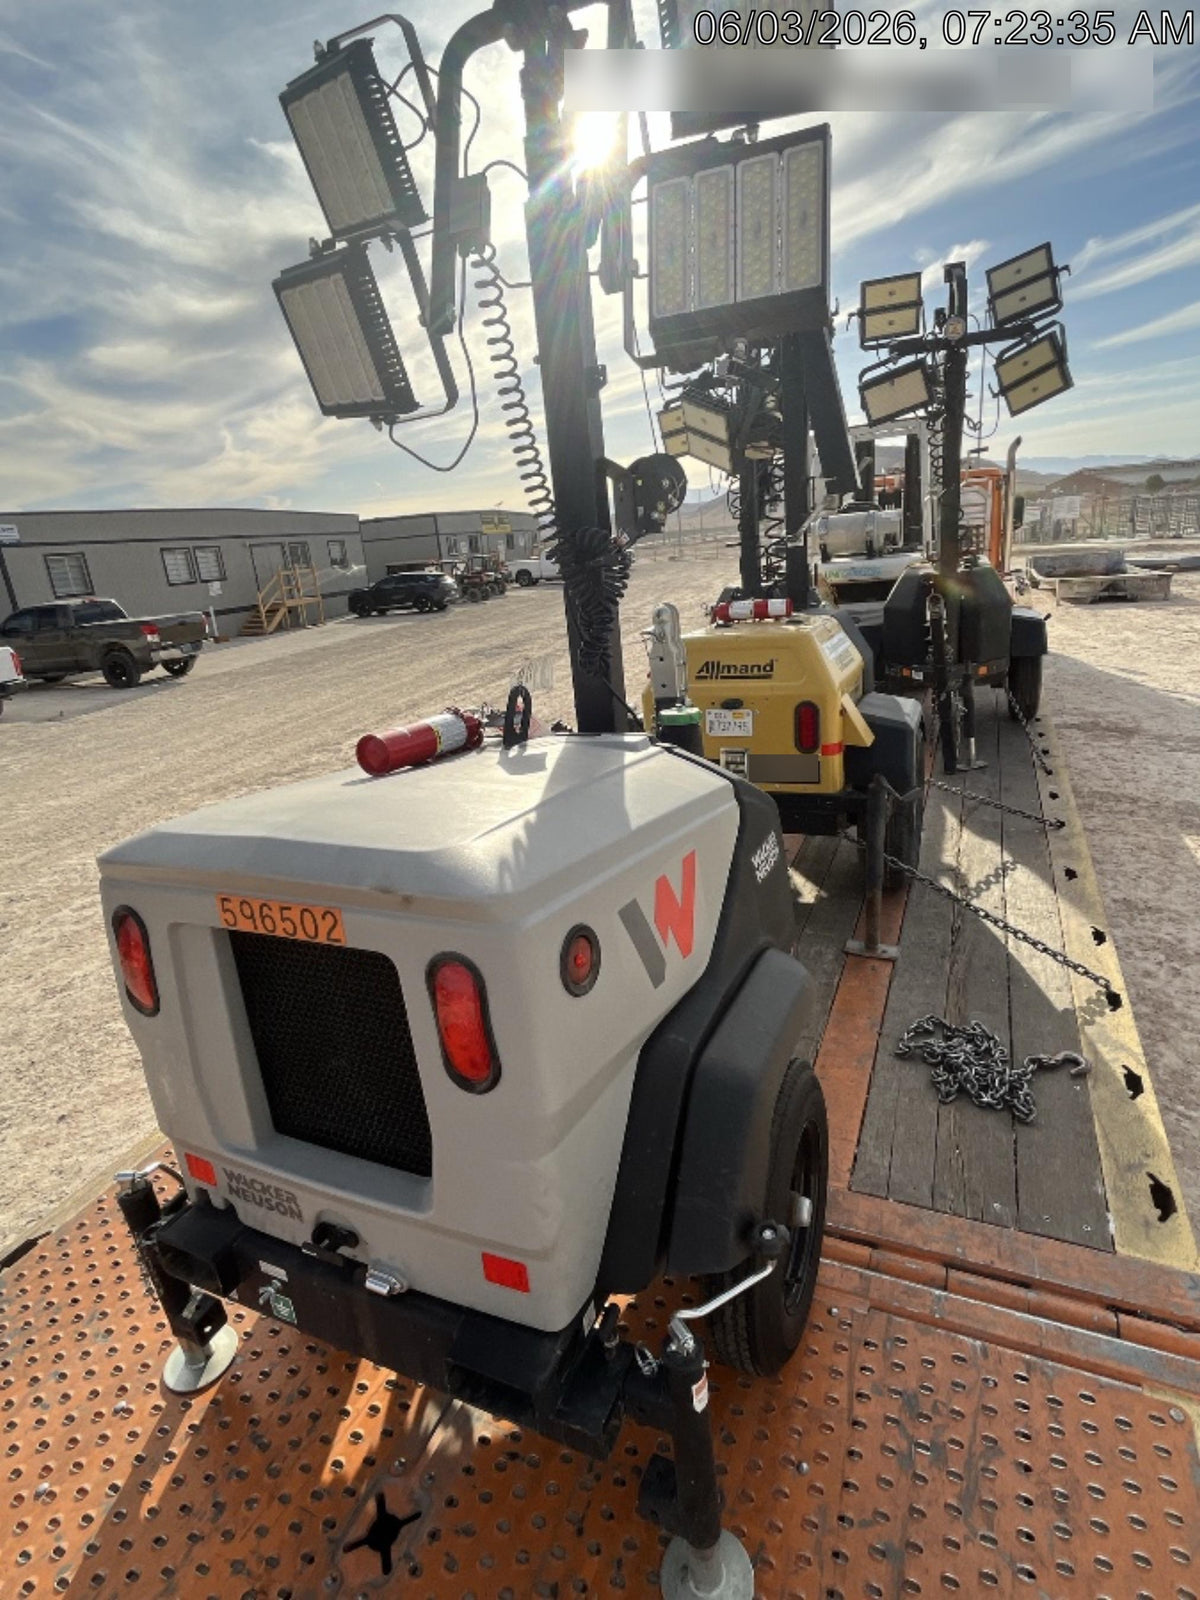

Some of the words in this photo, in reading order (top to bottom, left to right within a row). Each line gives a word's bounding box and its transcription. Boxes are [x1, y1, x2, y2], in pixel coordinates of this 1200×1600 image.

[696, 659, 774, 680] Allmand
[220, 897, 342, 943] 596502
[222, 1167, 300, 1208] WACKER
[227, 1182, 304, 1223] NEUSON
